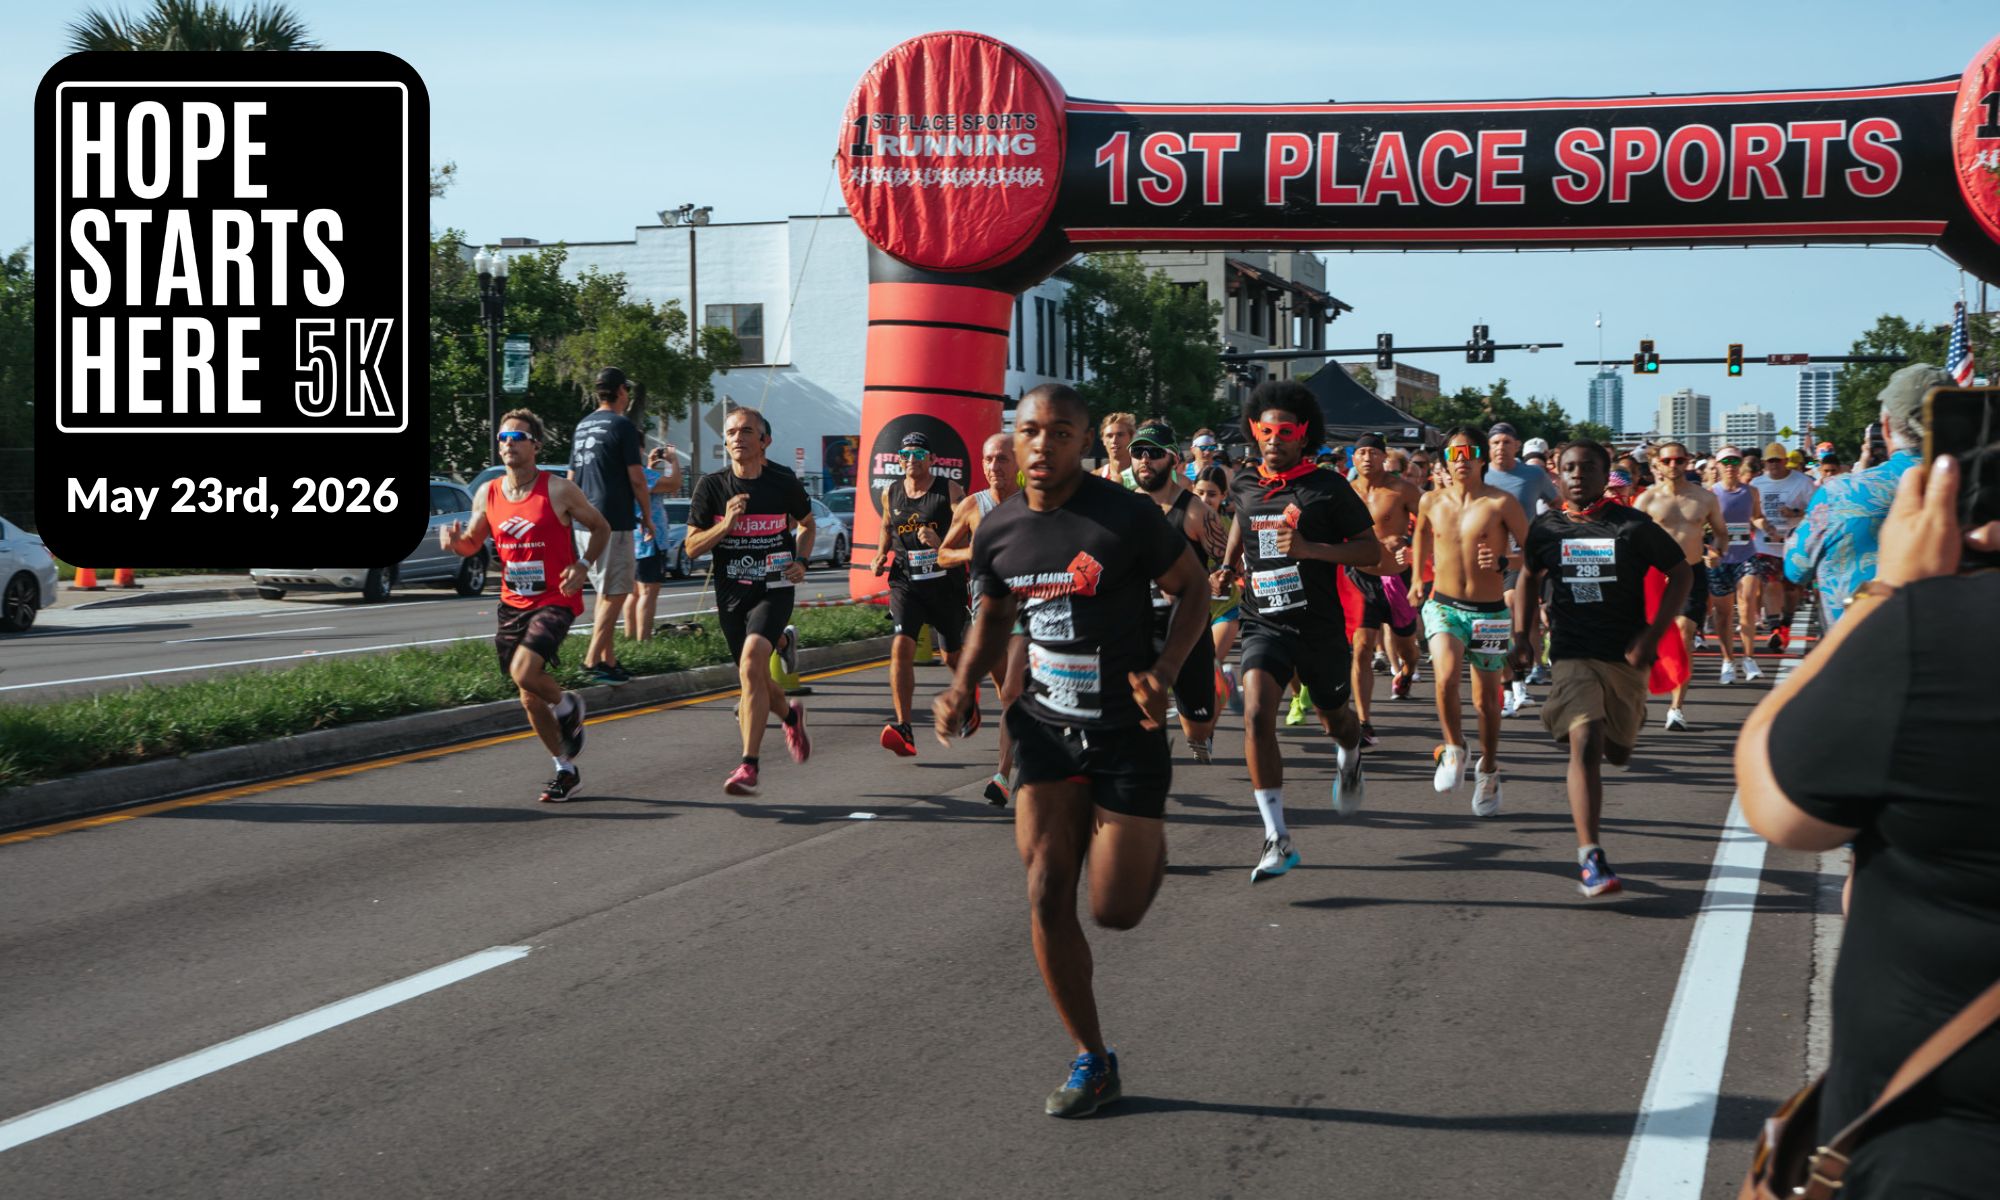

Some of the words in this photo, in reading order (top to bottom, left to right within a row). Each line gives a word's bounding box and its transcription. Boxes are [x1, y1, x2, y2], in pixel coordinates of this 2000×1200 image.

[898, 114, 956, 131] PLACE
[962, 113, 1038, 131] SPORTS
[877, 133, 1038, 157] RUNNING
[1095, 131, 1242, 206] 1ST
[1265, 129, 1527, 207] PLACE
[1552, 117, 1903, 205] SPORTS
[885, 463, 963, 480] RUING
[922, 565, 933, 574] 57
[1576, 565, 1600, 577] 298
[1036, 572, 1075, 584] AGAINST
[1268, 593, 1291, 607] 284
[1482, 640, 1501, 650] 212
